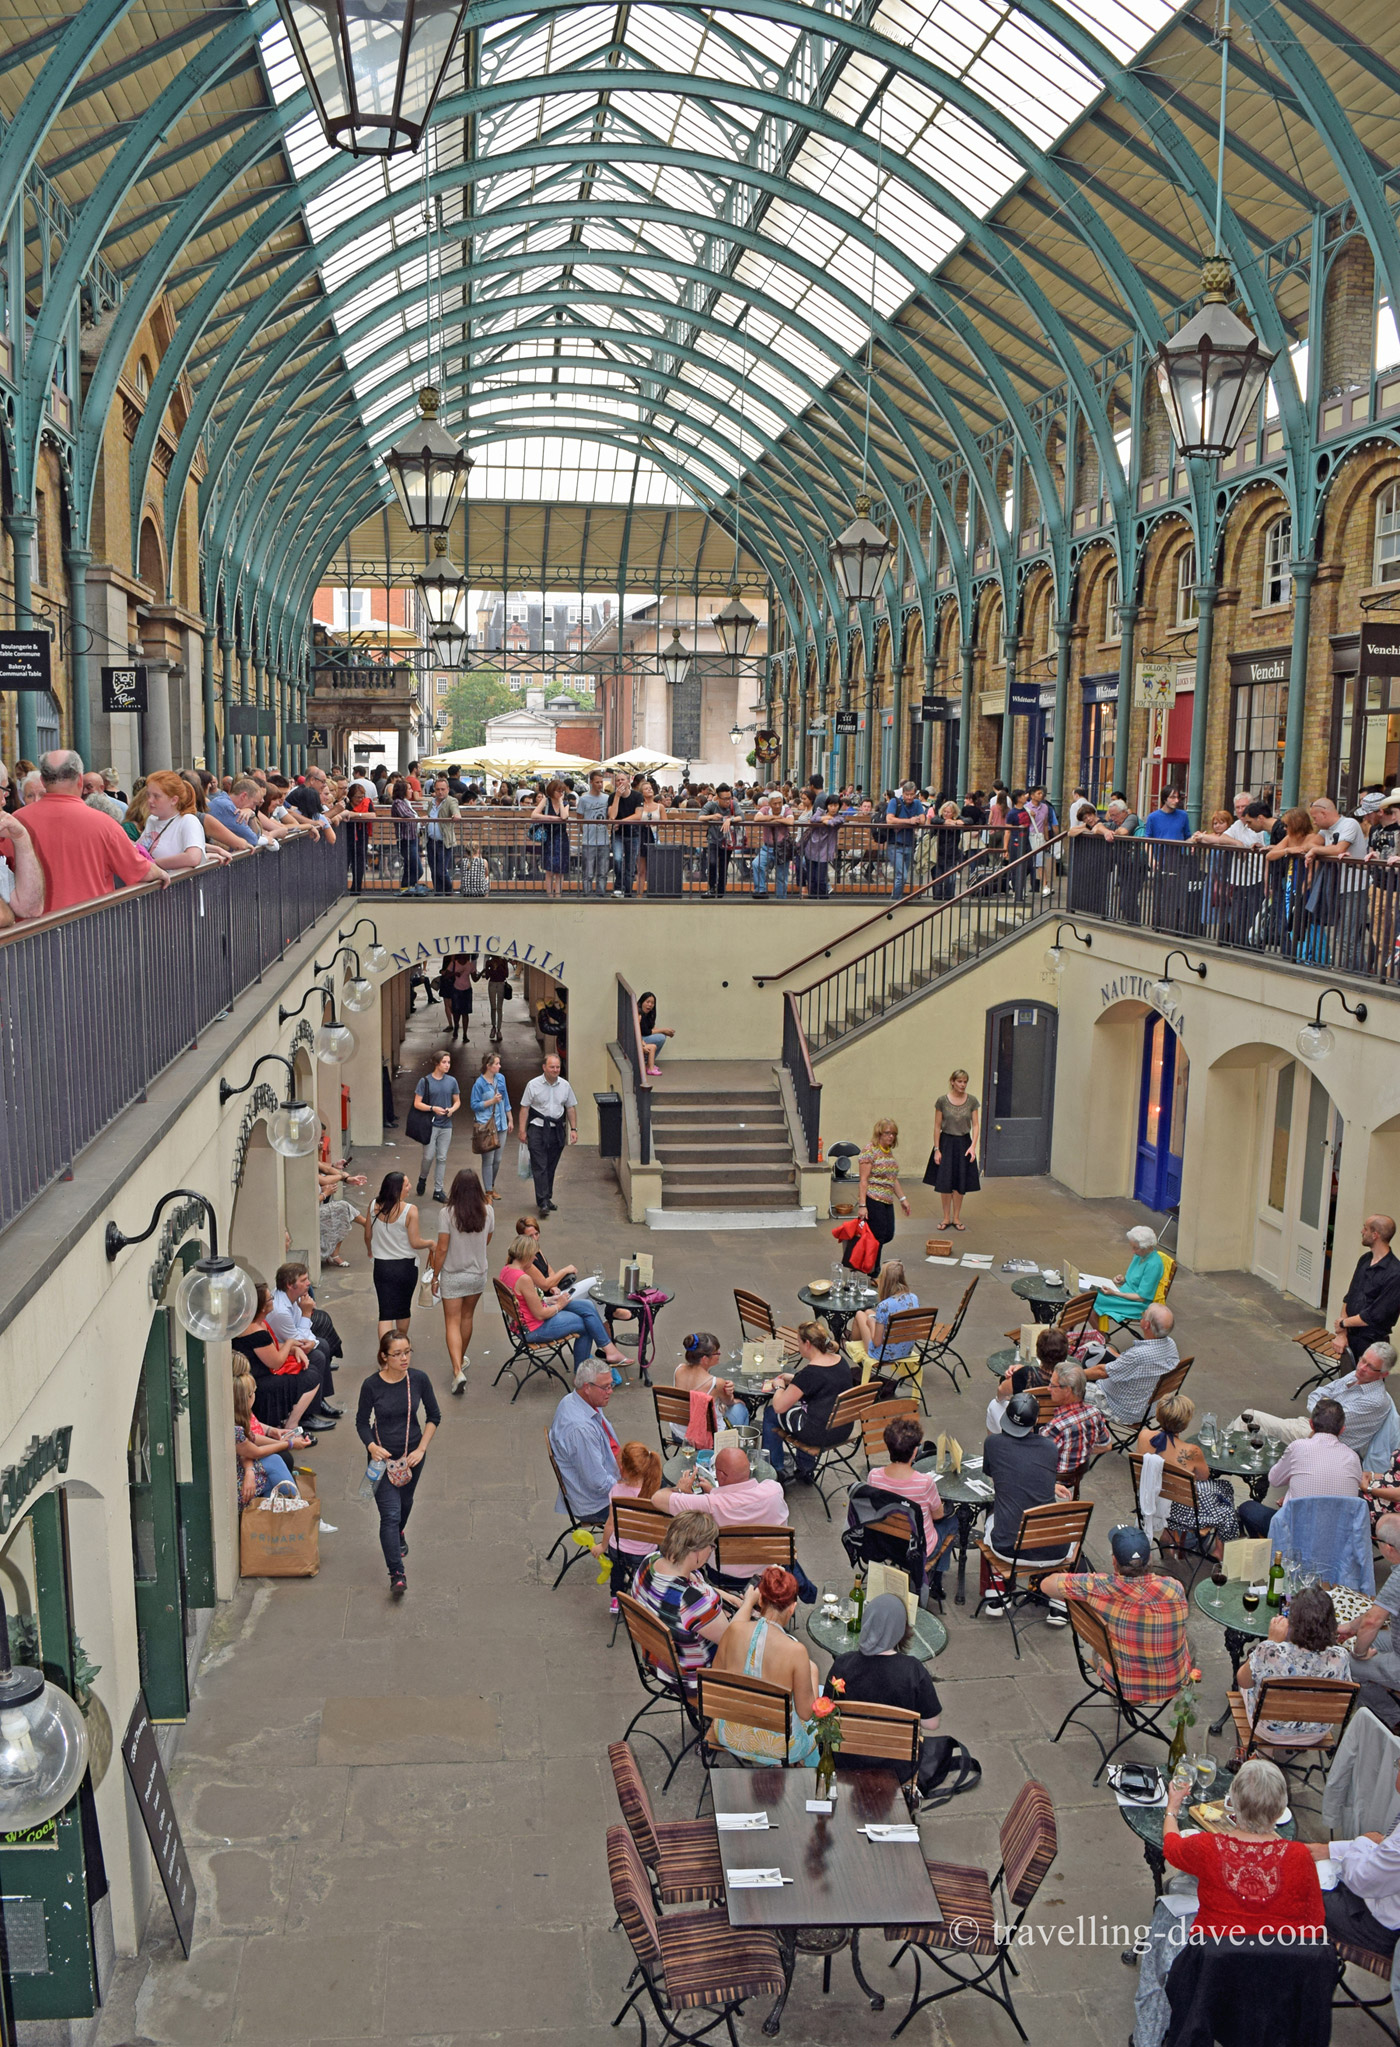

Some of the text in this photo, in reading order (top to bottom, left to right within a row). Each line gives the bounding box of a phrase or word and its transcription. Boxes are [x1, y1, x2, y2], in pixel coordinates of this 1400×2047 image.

[1367, 644, 1400, 655] Venchi
[1250, 661, 1285, 681] Venchi
[114, 693, 136, 704] Pain
[392, 935, 566, 979] NAUTICALIA
[250, 1532, 305, 1544] PRIMARK
